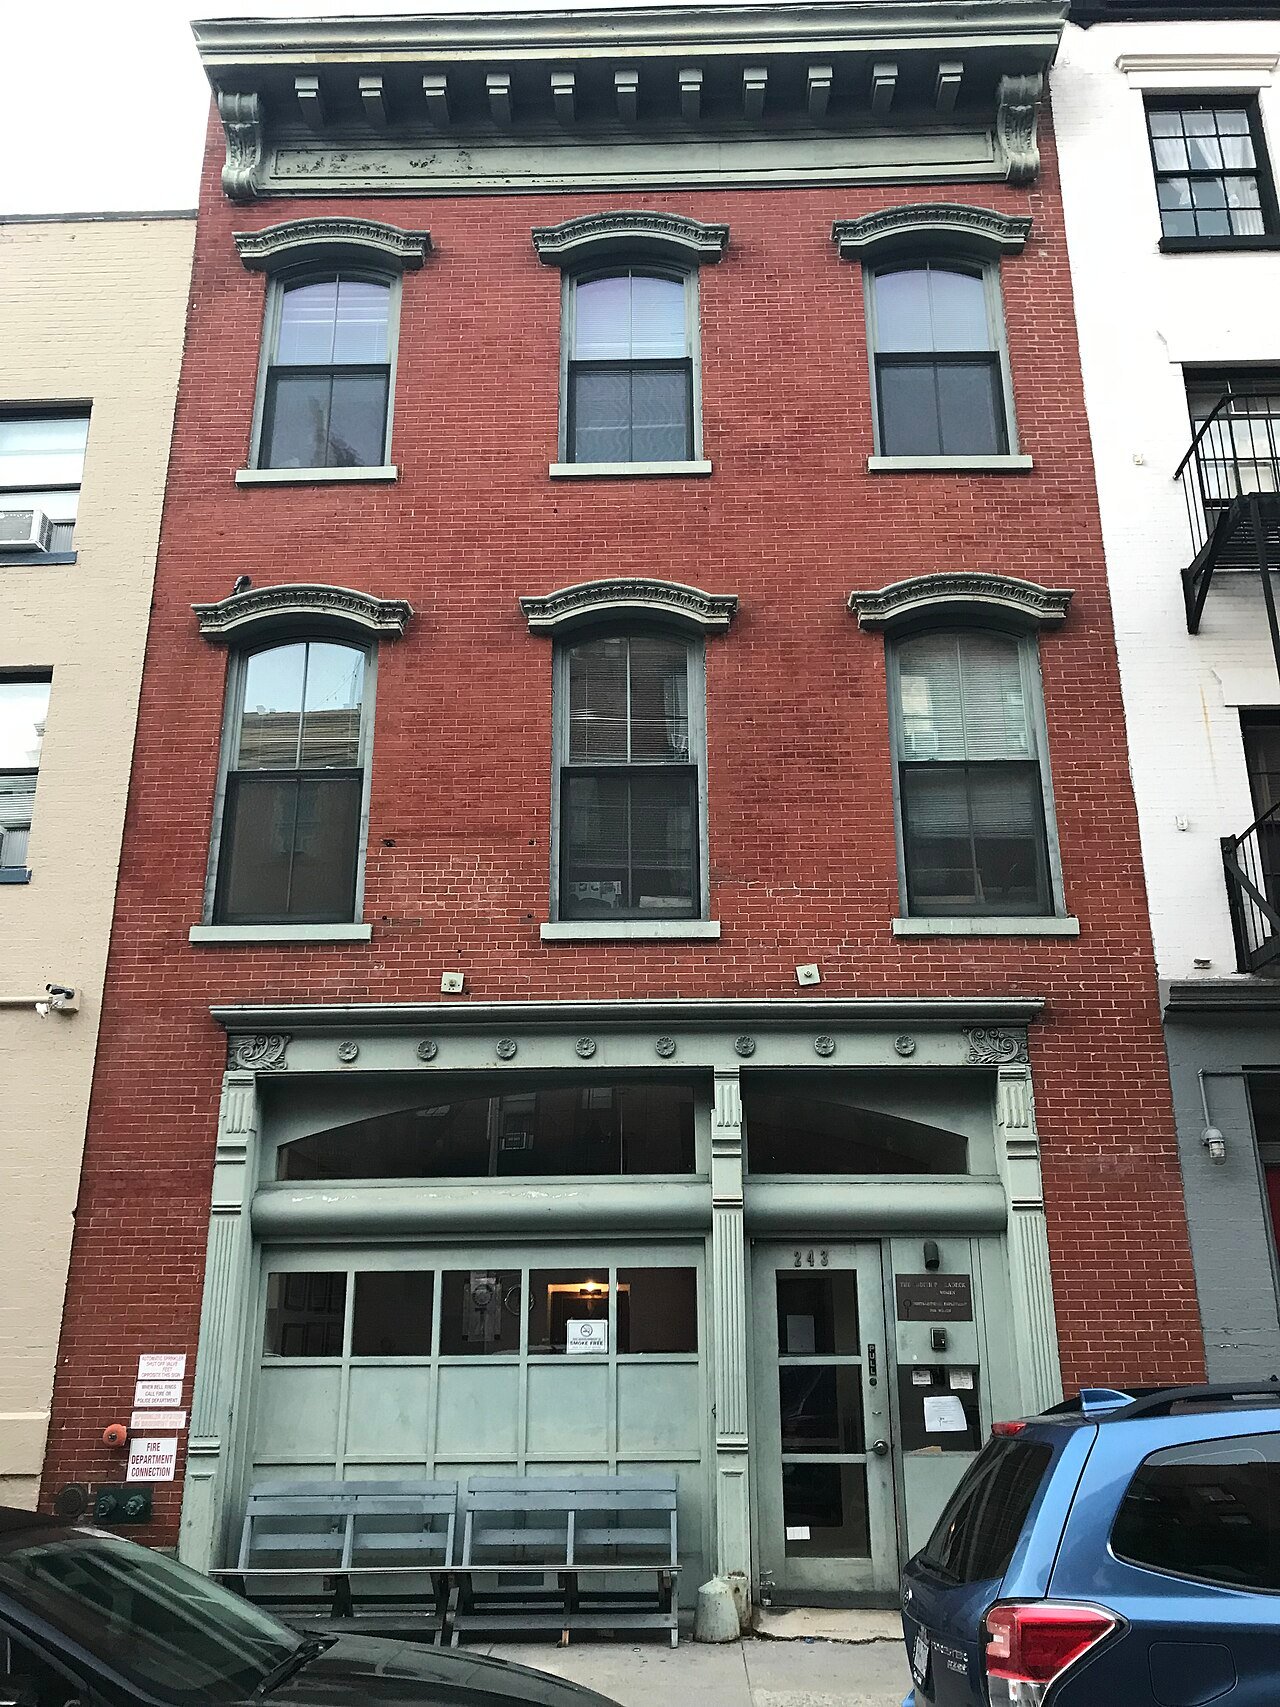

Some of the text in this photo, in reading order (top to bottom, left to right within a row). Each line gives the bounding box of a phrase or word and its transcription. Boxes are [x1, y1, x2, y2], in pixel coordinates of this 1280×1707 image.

[793, 1249, 829, 1267] 243
[146, 1442, 161, 1452] FIRE
[131, 1454, 173, 1465] DEPARTMENT
[131, 1467, 171, 1477] CONNECTION
